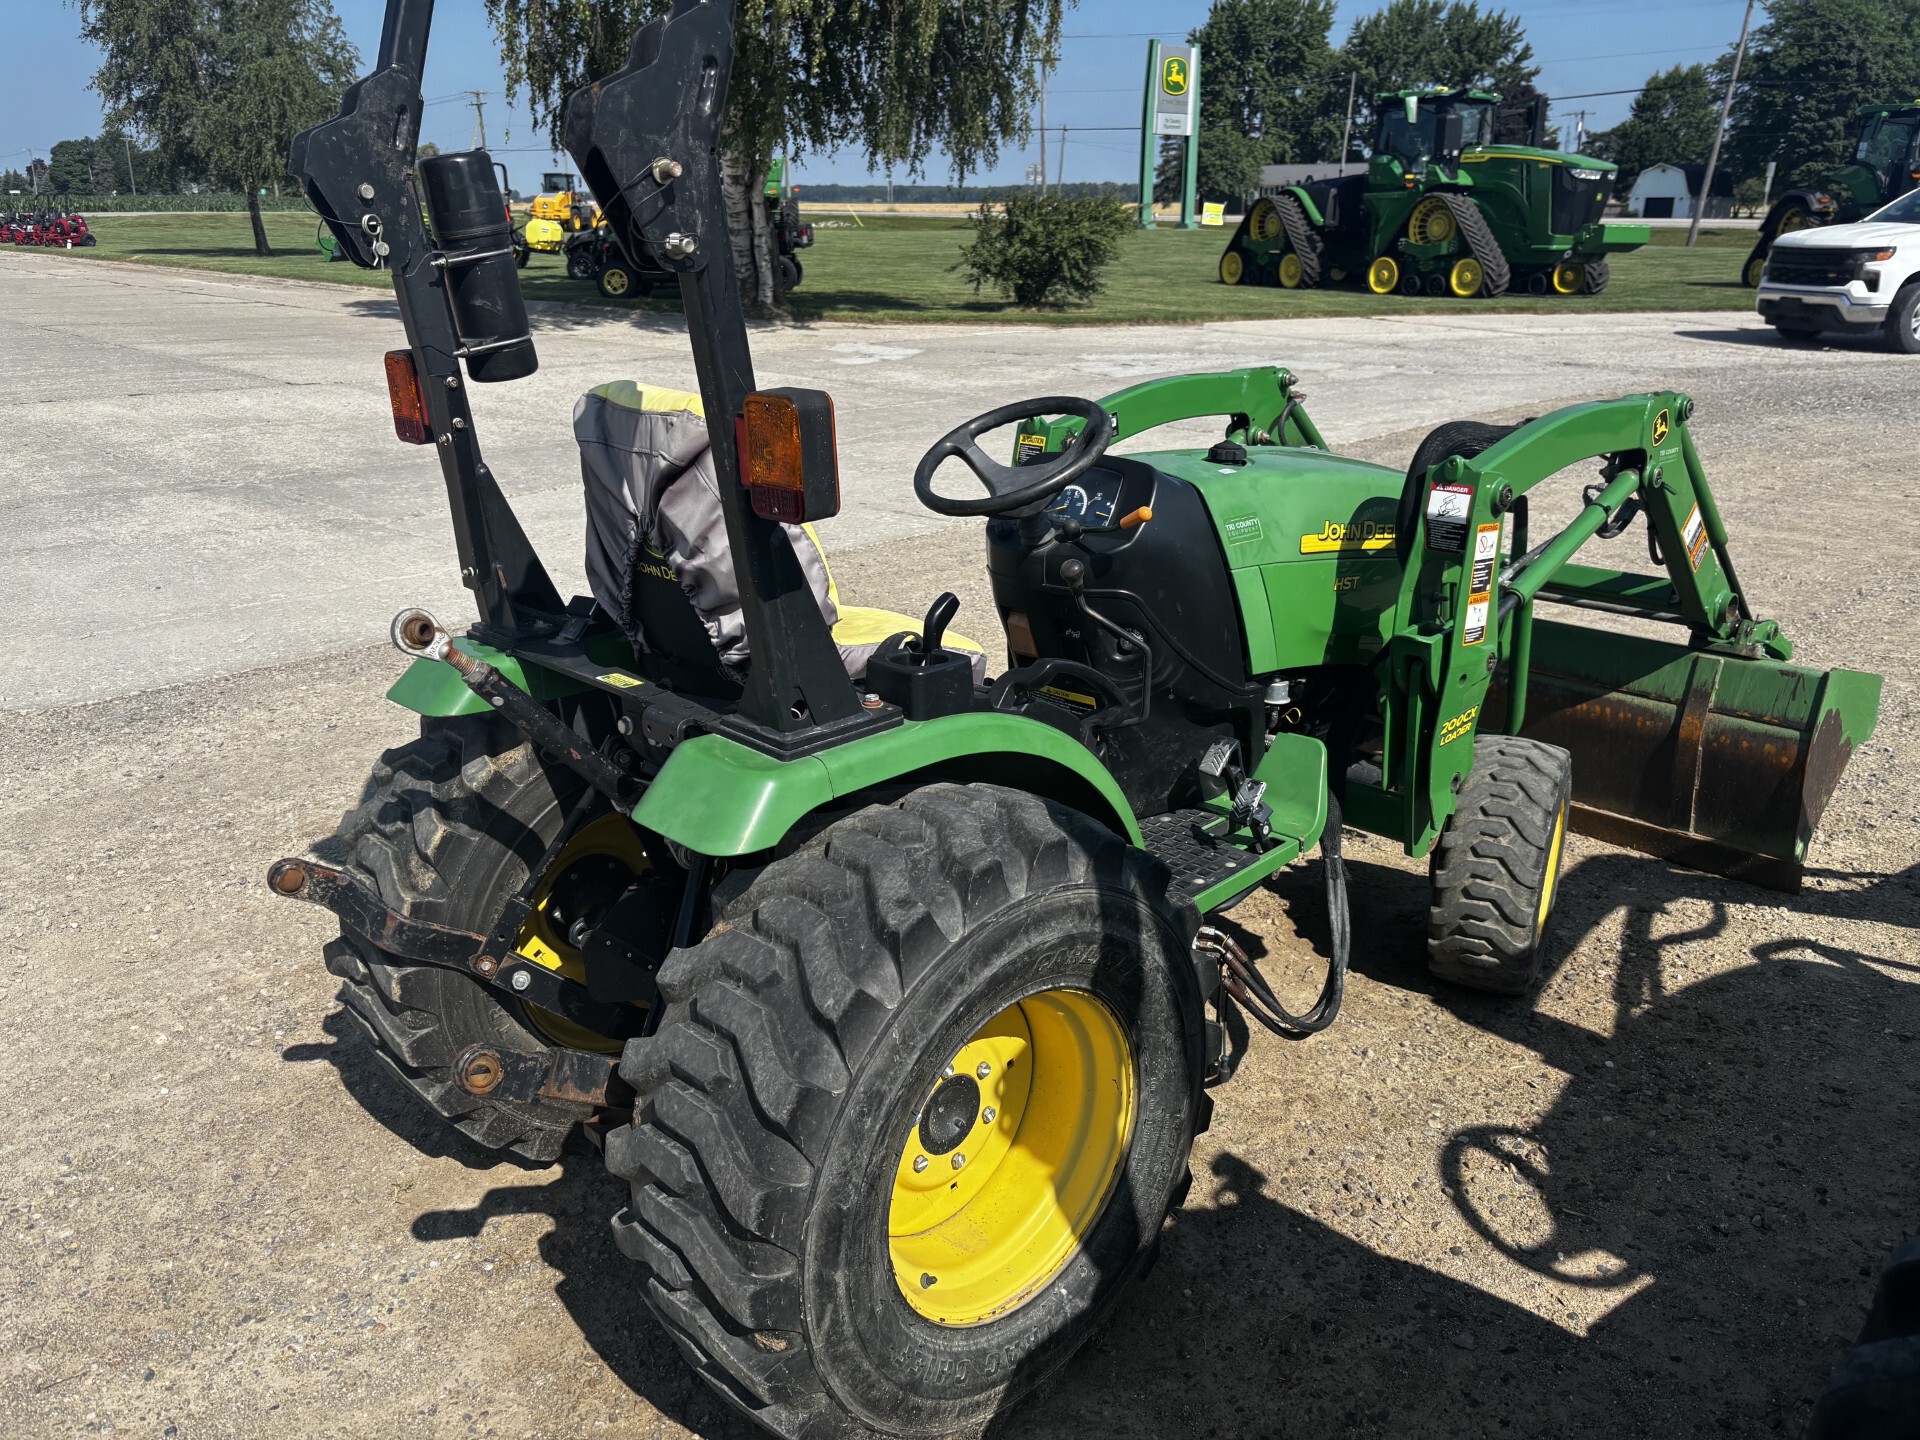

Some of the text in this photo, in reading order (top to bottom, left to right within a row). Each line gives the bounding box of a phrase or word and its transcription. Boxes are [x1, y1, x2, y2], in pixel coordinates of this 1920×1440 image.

[1444, 485, 1469, 494] DANGER
[1225, 518, 1260, 532] TRI COUNTY
[1227, 525, 1259, 537] EQUIPMENT
[1317, 520, 1397, 541] JOHN DEE
[1333, 576, 1361, 592] HST
[1440, 705, 1479, 736] 200CX
[1440, 722, 1472, 747] LOADER
